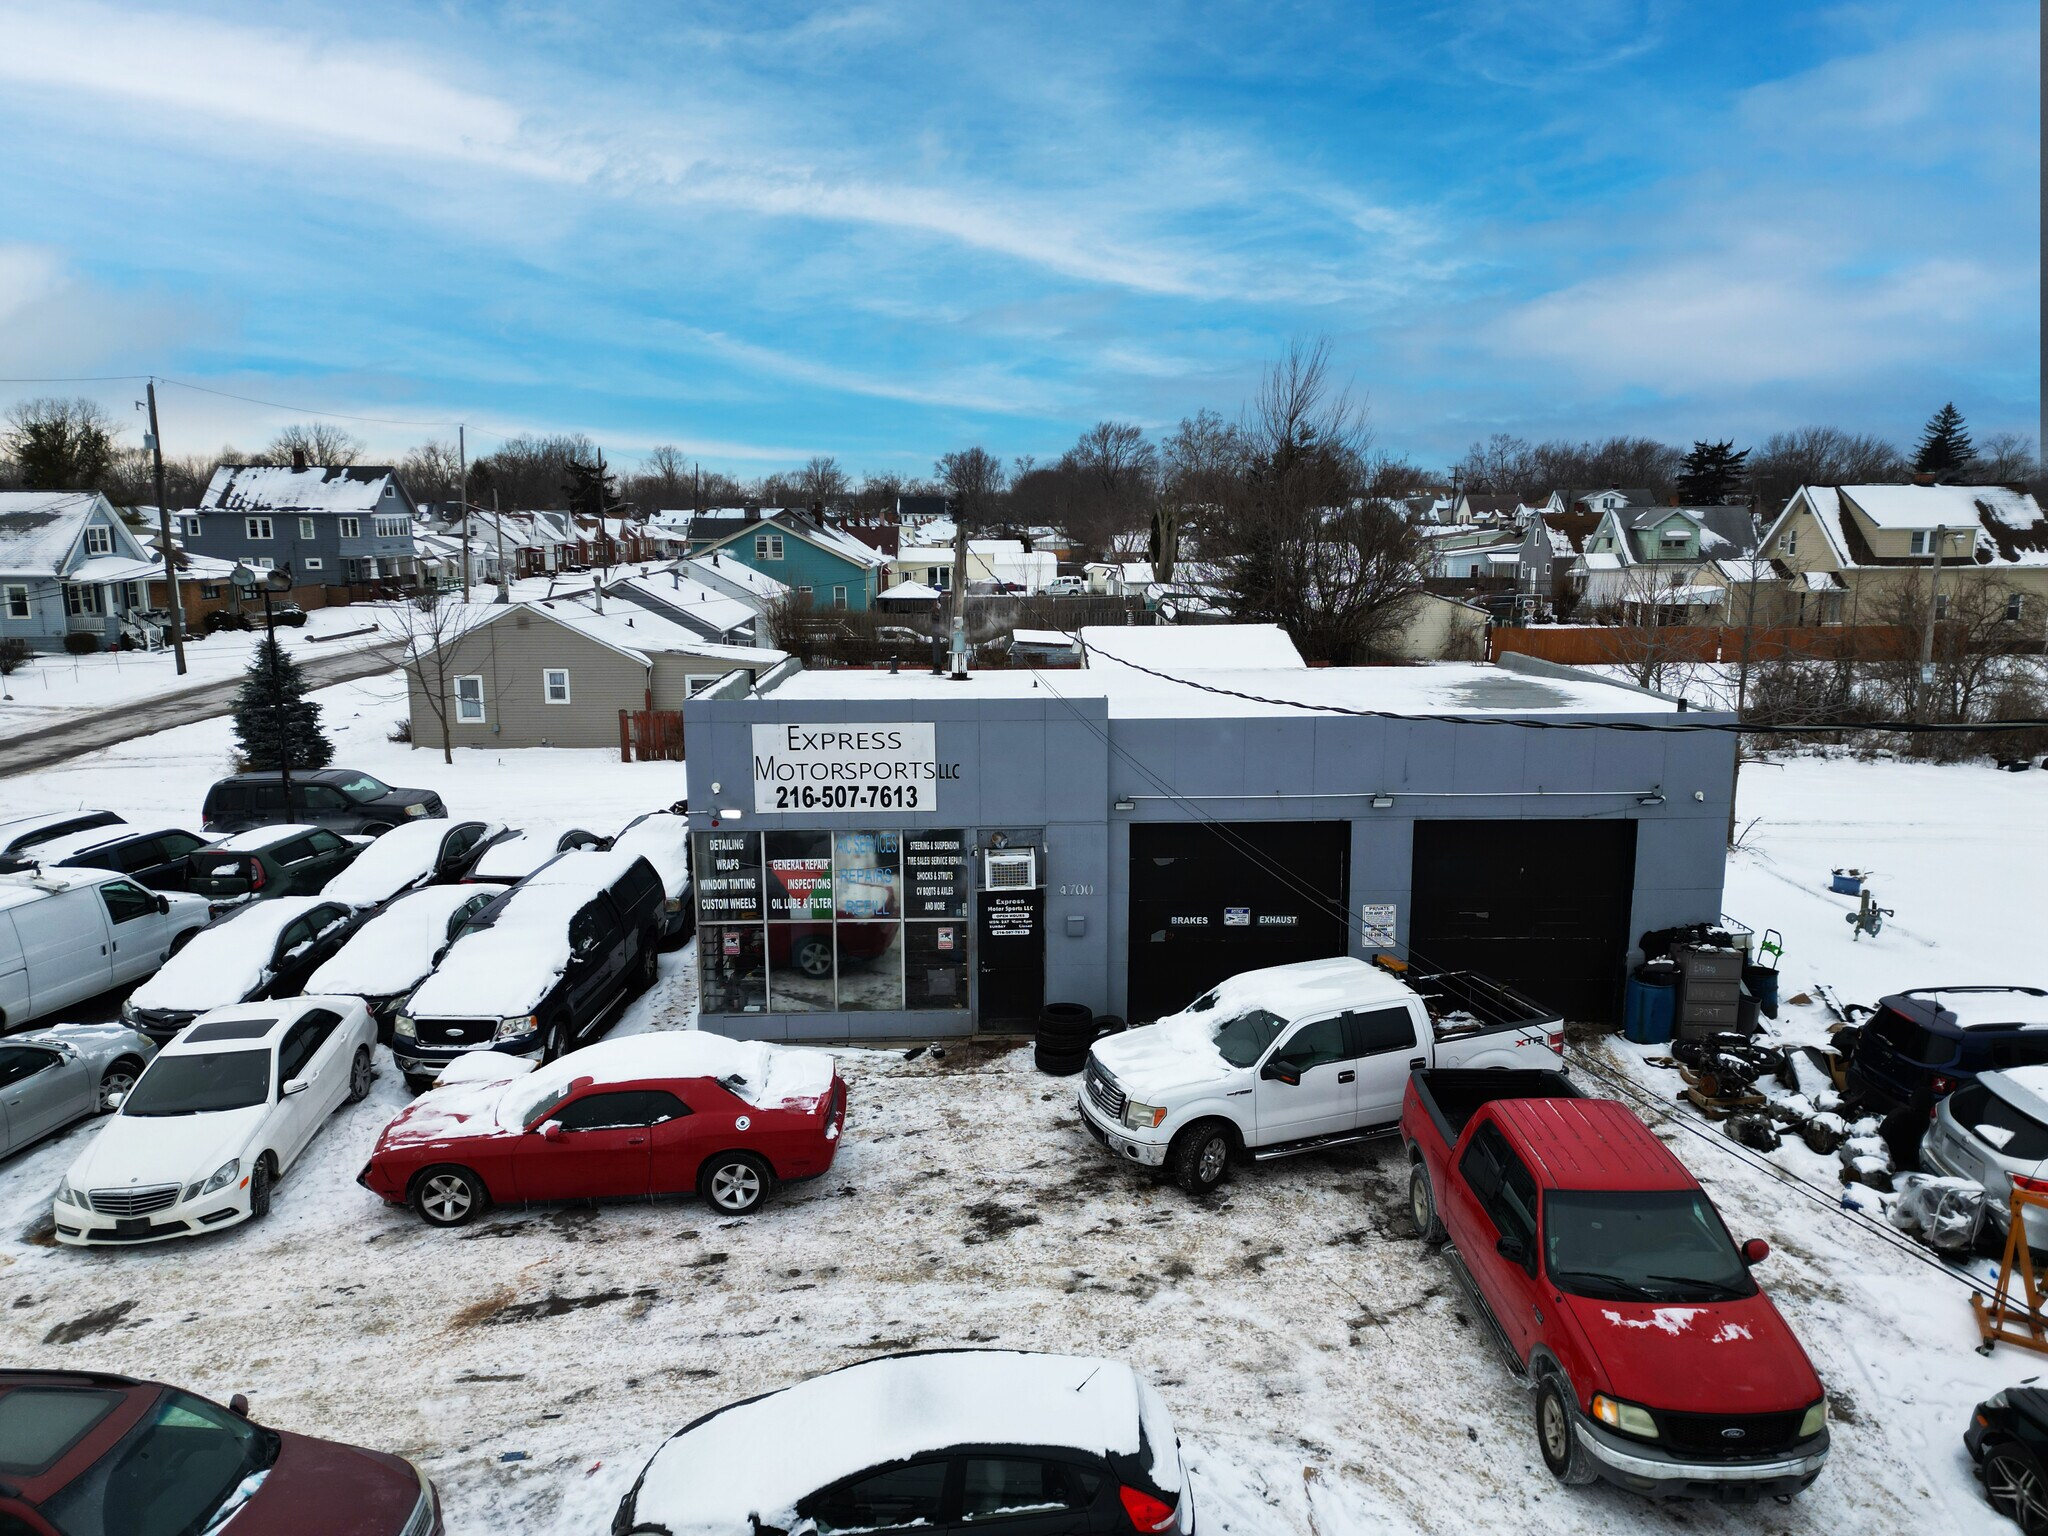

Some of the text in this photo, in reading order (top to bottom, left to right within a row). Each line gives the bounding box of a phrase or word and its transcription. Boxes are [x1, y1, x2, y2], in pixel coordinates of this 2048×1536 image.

[787, 725, 902, 751] EXPRESS
[938, 763, 960, 779] LLC
[776, 785, 918, 809] 216-507-7613
[709, 839, 744, 851] DETAILING
[854, 834, 898, 854] SERVICES
[934, 841, 960, 850] SUSPENSION
[716, 859, 740, 870] WRAPS
[773, 860, 829, 871] GENERAL REPAIR
[840, 868, 893, 883] REPAIRS
[917, 871, 933, 880] SHOCKS
[938, 871, 953, 880] STRUTS
[700, 878, 756, 890] WINDOW TINTING
[787, 879, 831, 890] INSPECTIONS
[1059, 884, 1094, 896] 4700
[917, 887, 922, 896] CV
[923, 887, 936, 897] BOOTS
[701, 898, 756, 910] CUSTOM WHEELS
[771, 899, 782, 909] OIL
[784, 898, 801, 909] LUBE
[810, 898, 832, 909] FILTER
[845, 899, 890, 915] REFILL
[924, 902, 934, 911] AND
[934, 902, 946, 911] MORE
[1259, 916, 1298, 924] EXHAUST
